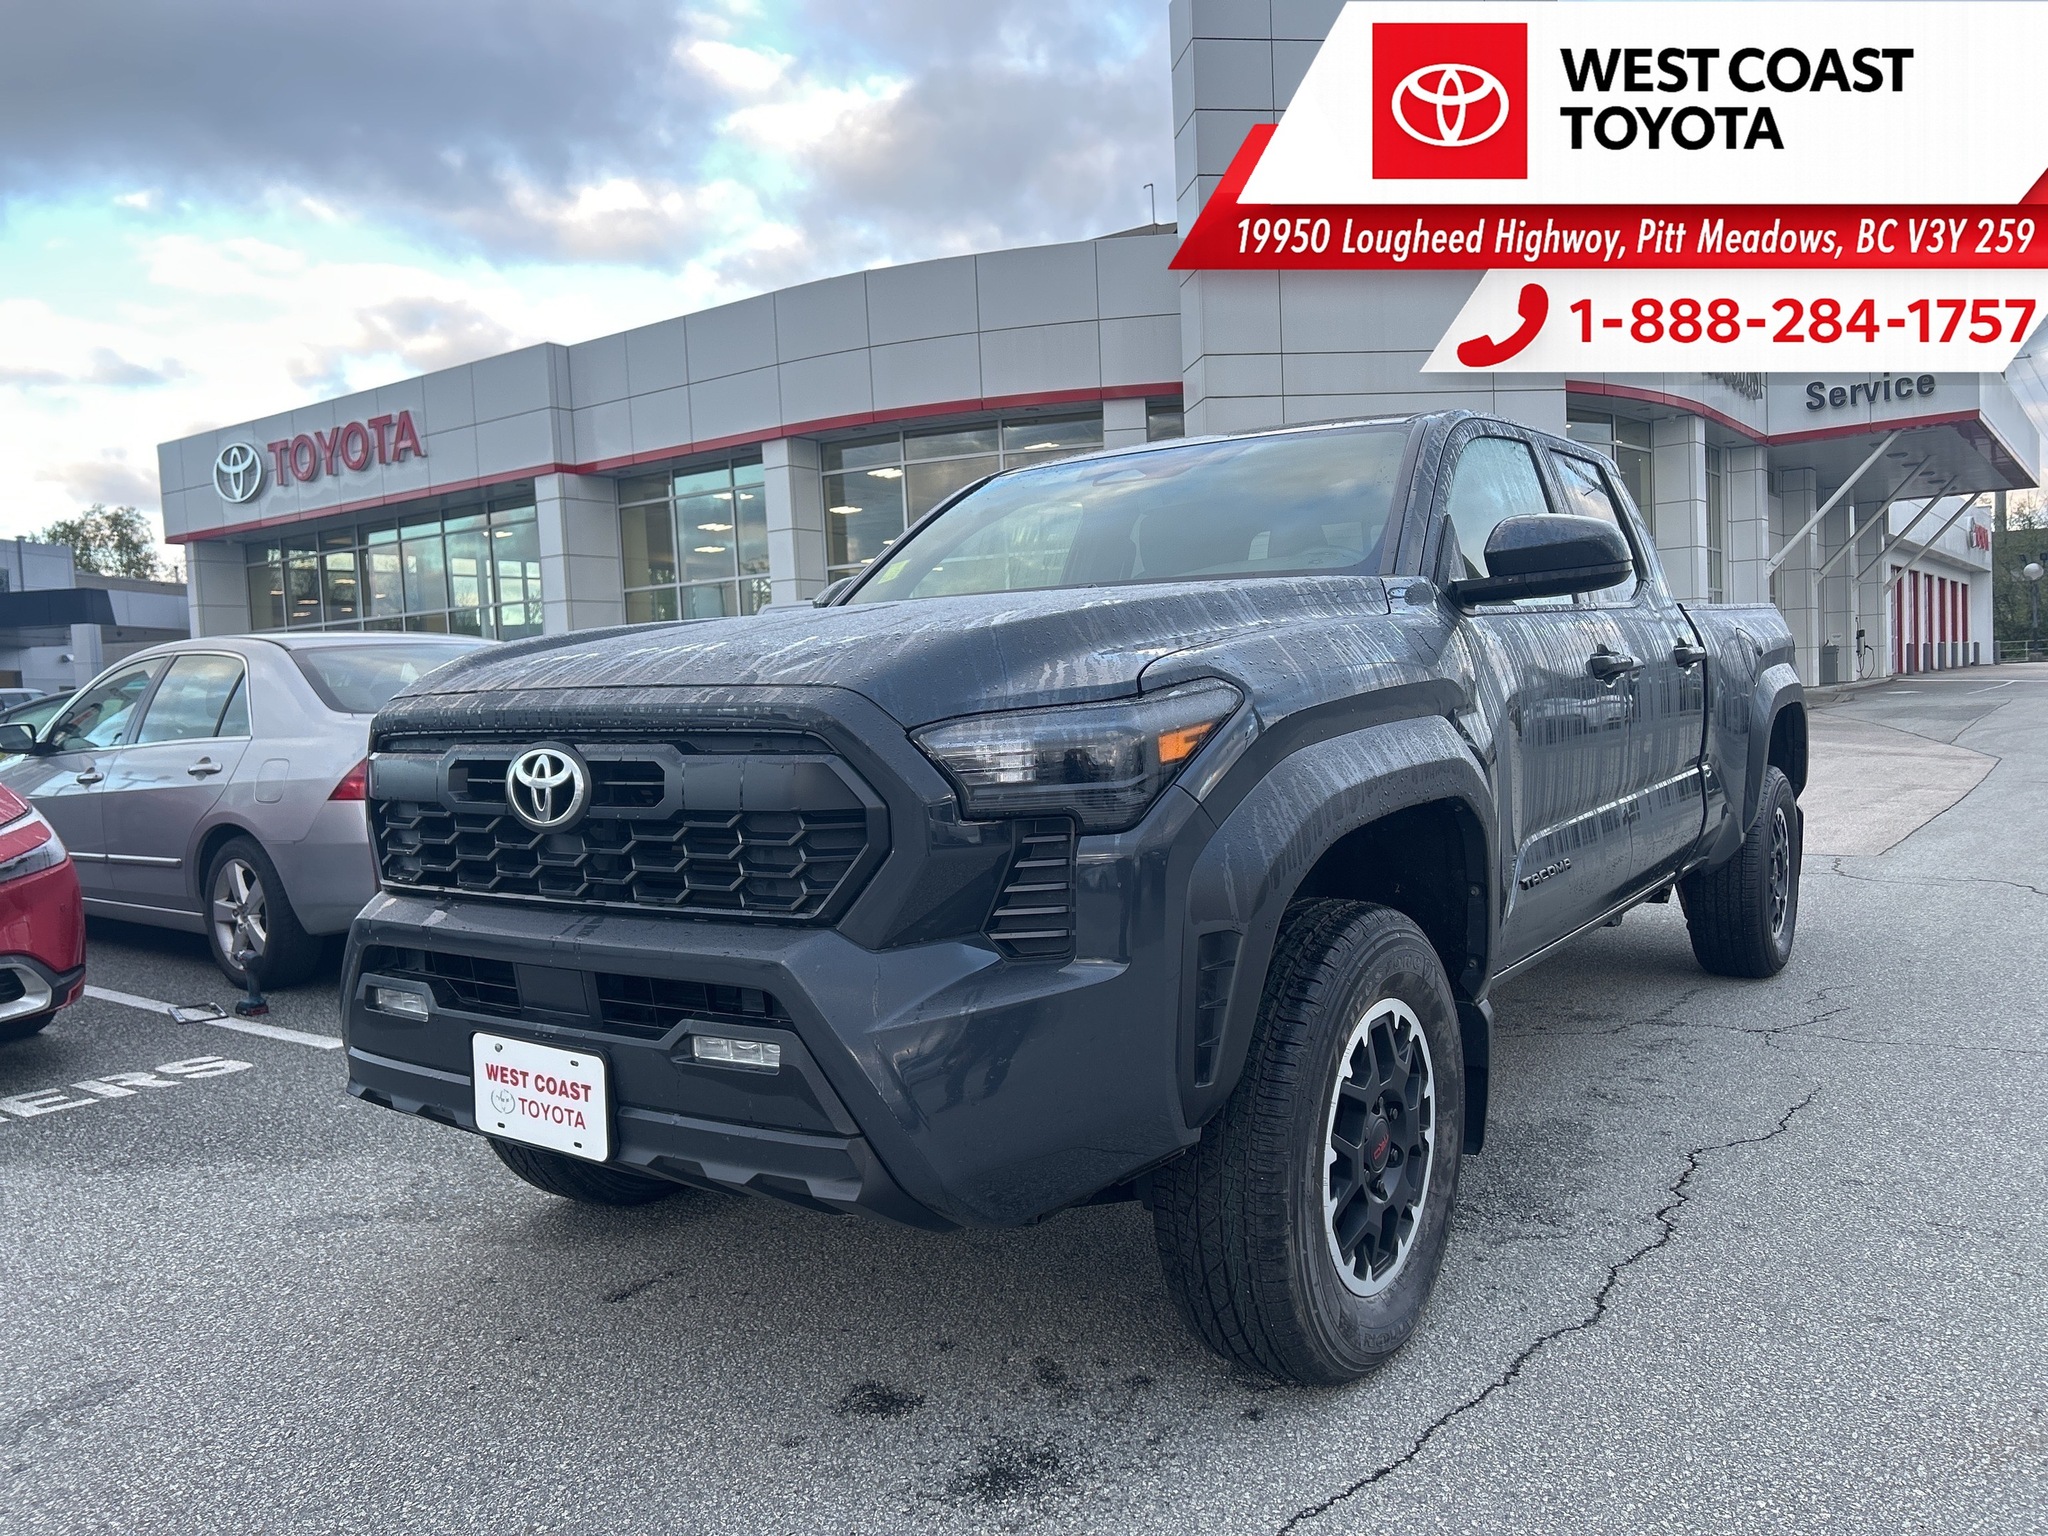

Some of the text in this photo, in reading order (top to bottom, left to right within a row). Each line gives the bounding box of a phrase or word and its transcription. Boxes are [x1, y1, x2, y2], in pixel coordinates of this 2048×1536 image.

[1806, 372, 1936, 411] Service
[267, 409, 426, 487] TOYOTA
[0, 1052, 254, 1124] ERS
[485, 1063, 592, 1102] WEST COAST
[518, 1097, 586, 1130] TOYOTA
